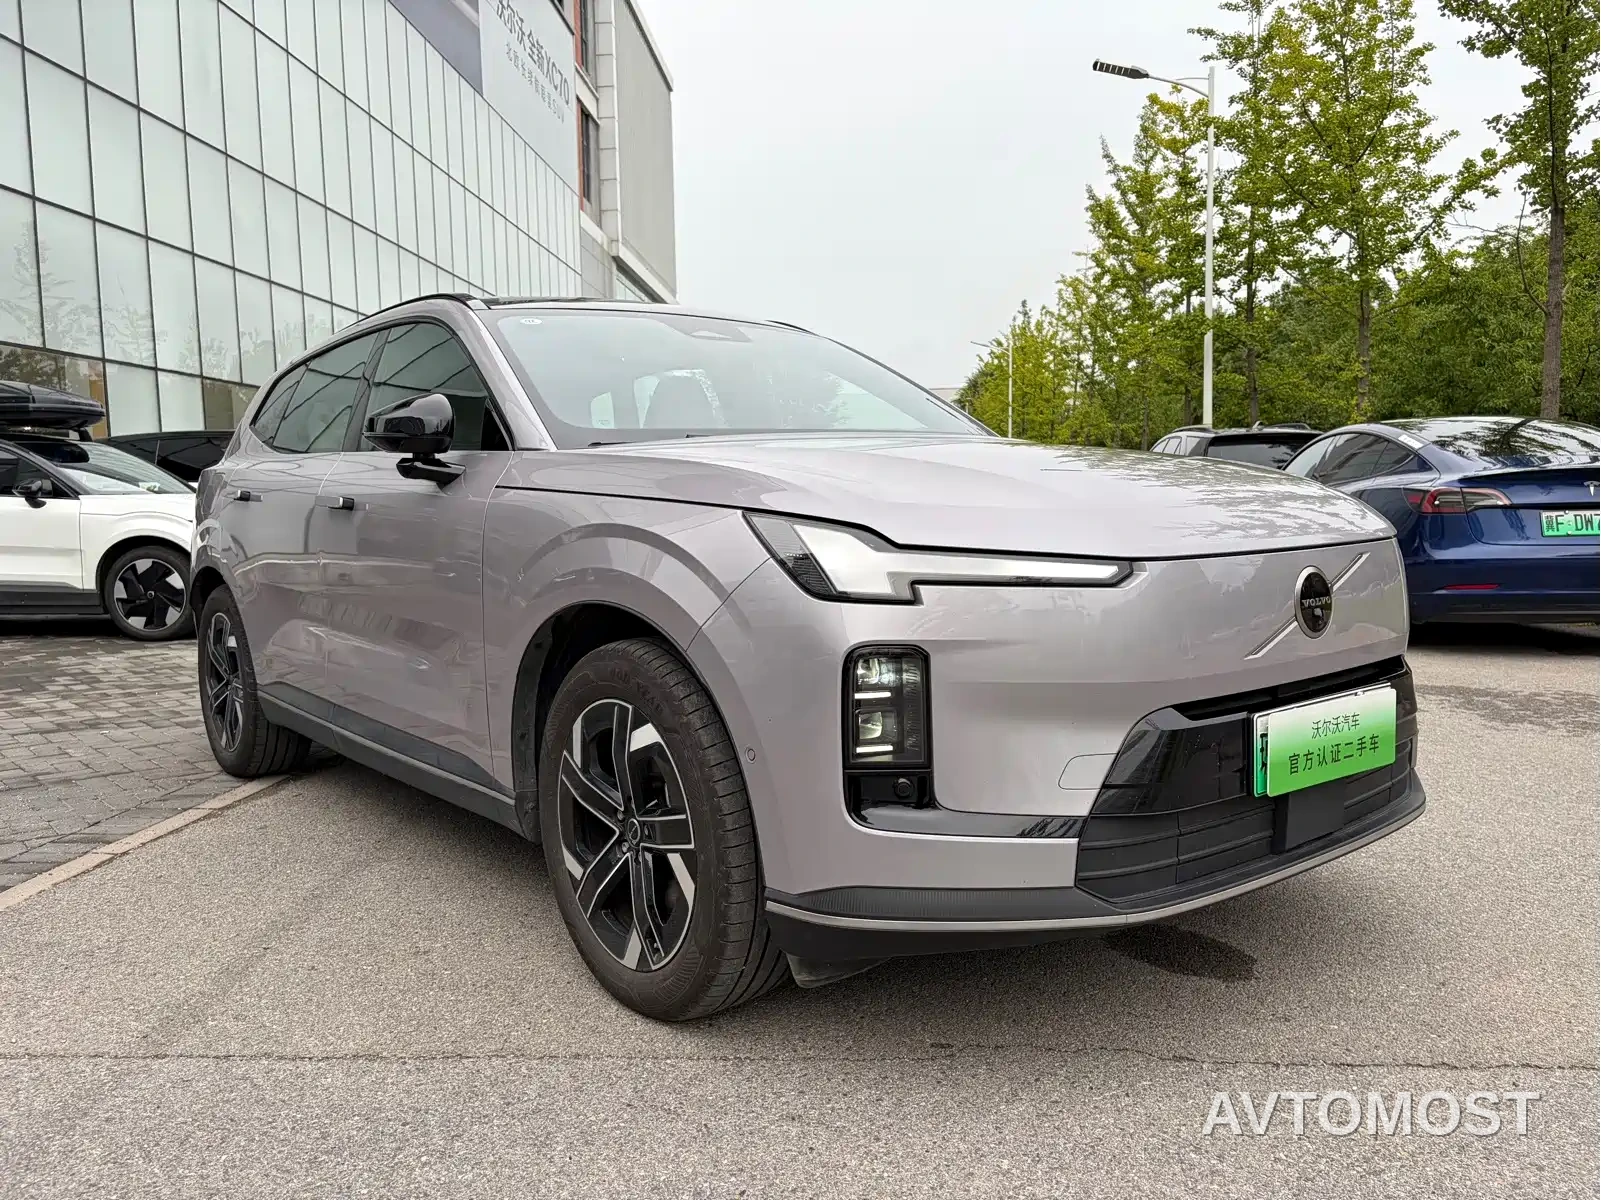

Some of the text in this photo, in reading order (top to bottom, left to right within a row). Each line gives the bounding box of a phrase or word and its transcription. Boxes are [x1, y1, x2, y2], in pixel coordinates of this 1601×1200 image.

[1302, 596, 1331, 607] VOLVO
[1311, 712, 1360, 739] 沃尔沃汽车
[1288, 734, 1380, 775] 官方认证二手车
